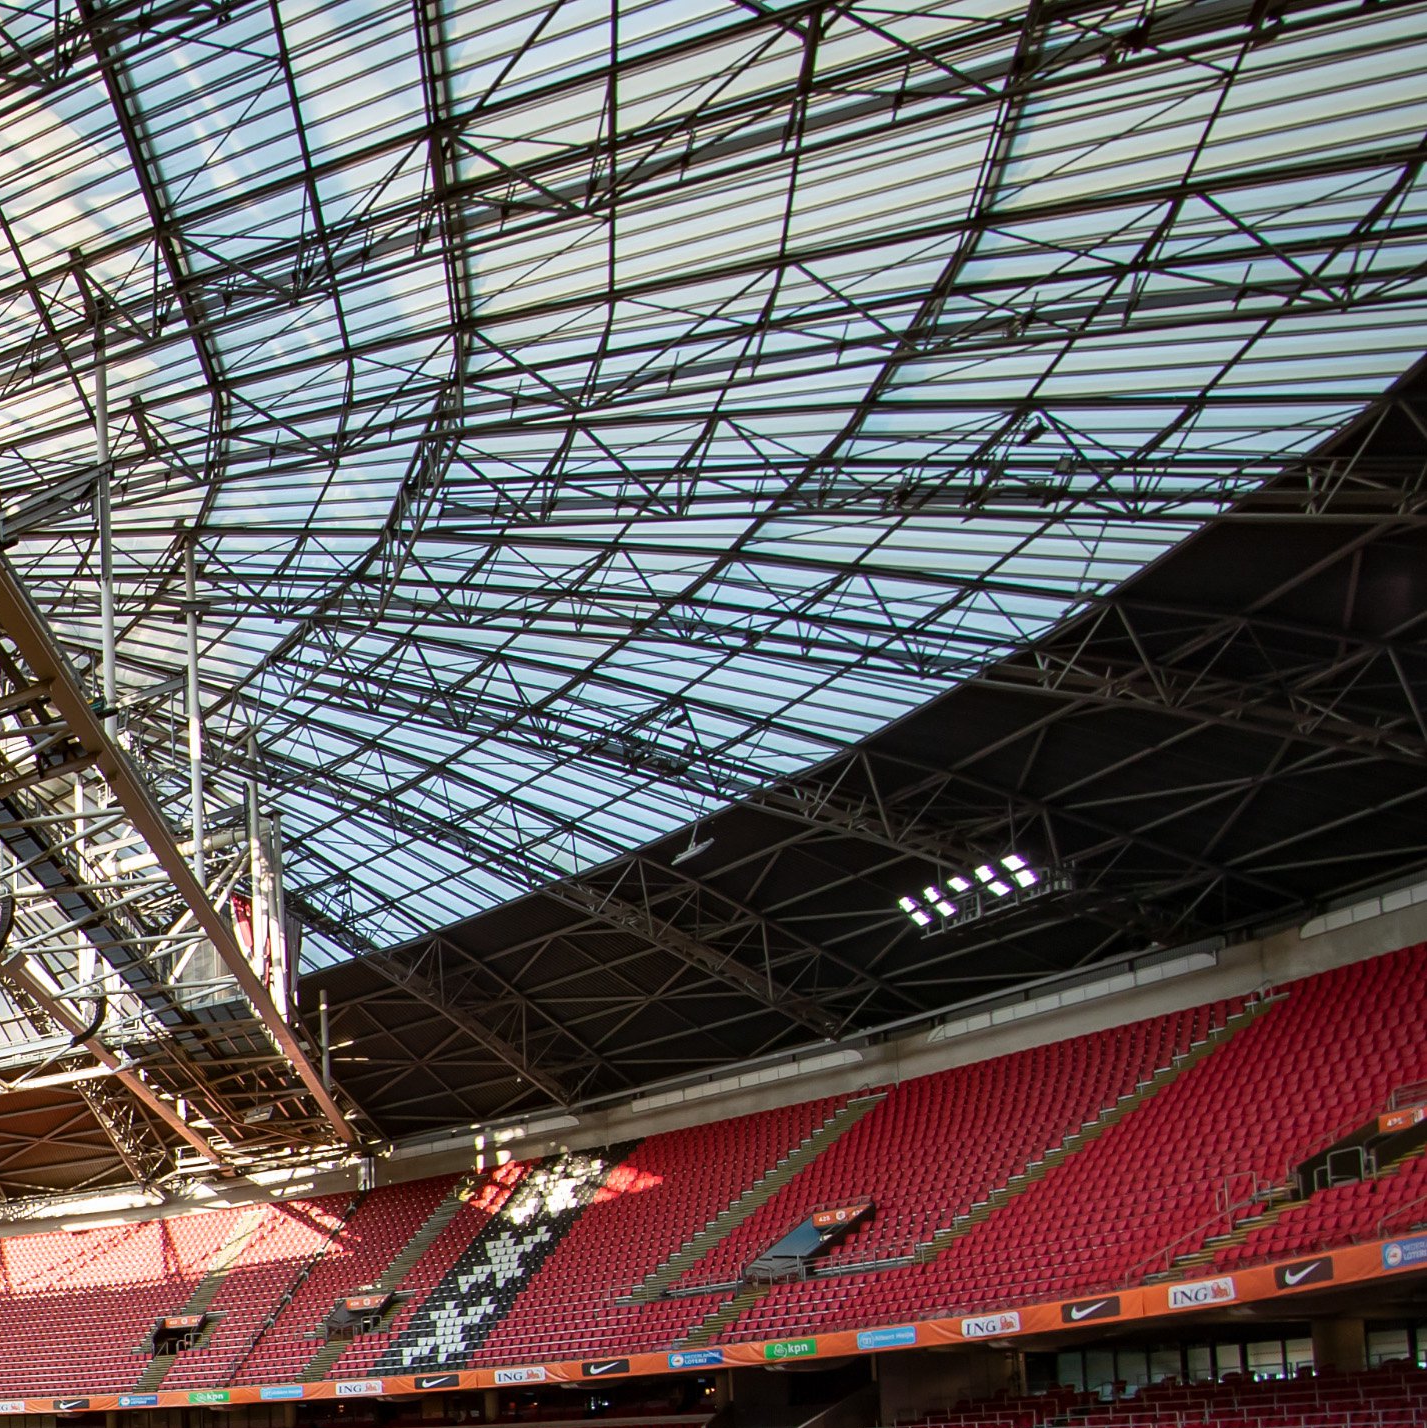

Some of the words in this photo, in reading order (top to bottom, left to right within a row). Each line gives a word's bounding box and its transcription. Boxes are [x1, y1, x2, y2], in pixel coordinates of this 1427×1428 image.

[1172, 1287, 1208, 1307] ING
[965, 1320, 996, 1336] ING
[787, 1342, 808, 1355] kpn
[498, 1371, 523, 1383] ING
[338, 1383, 362, 1394] ING
[206, 1392, 224, 1402] kpn
